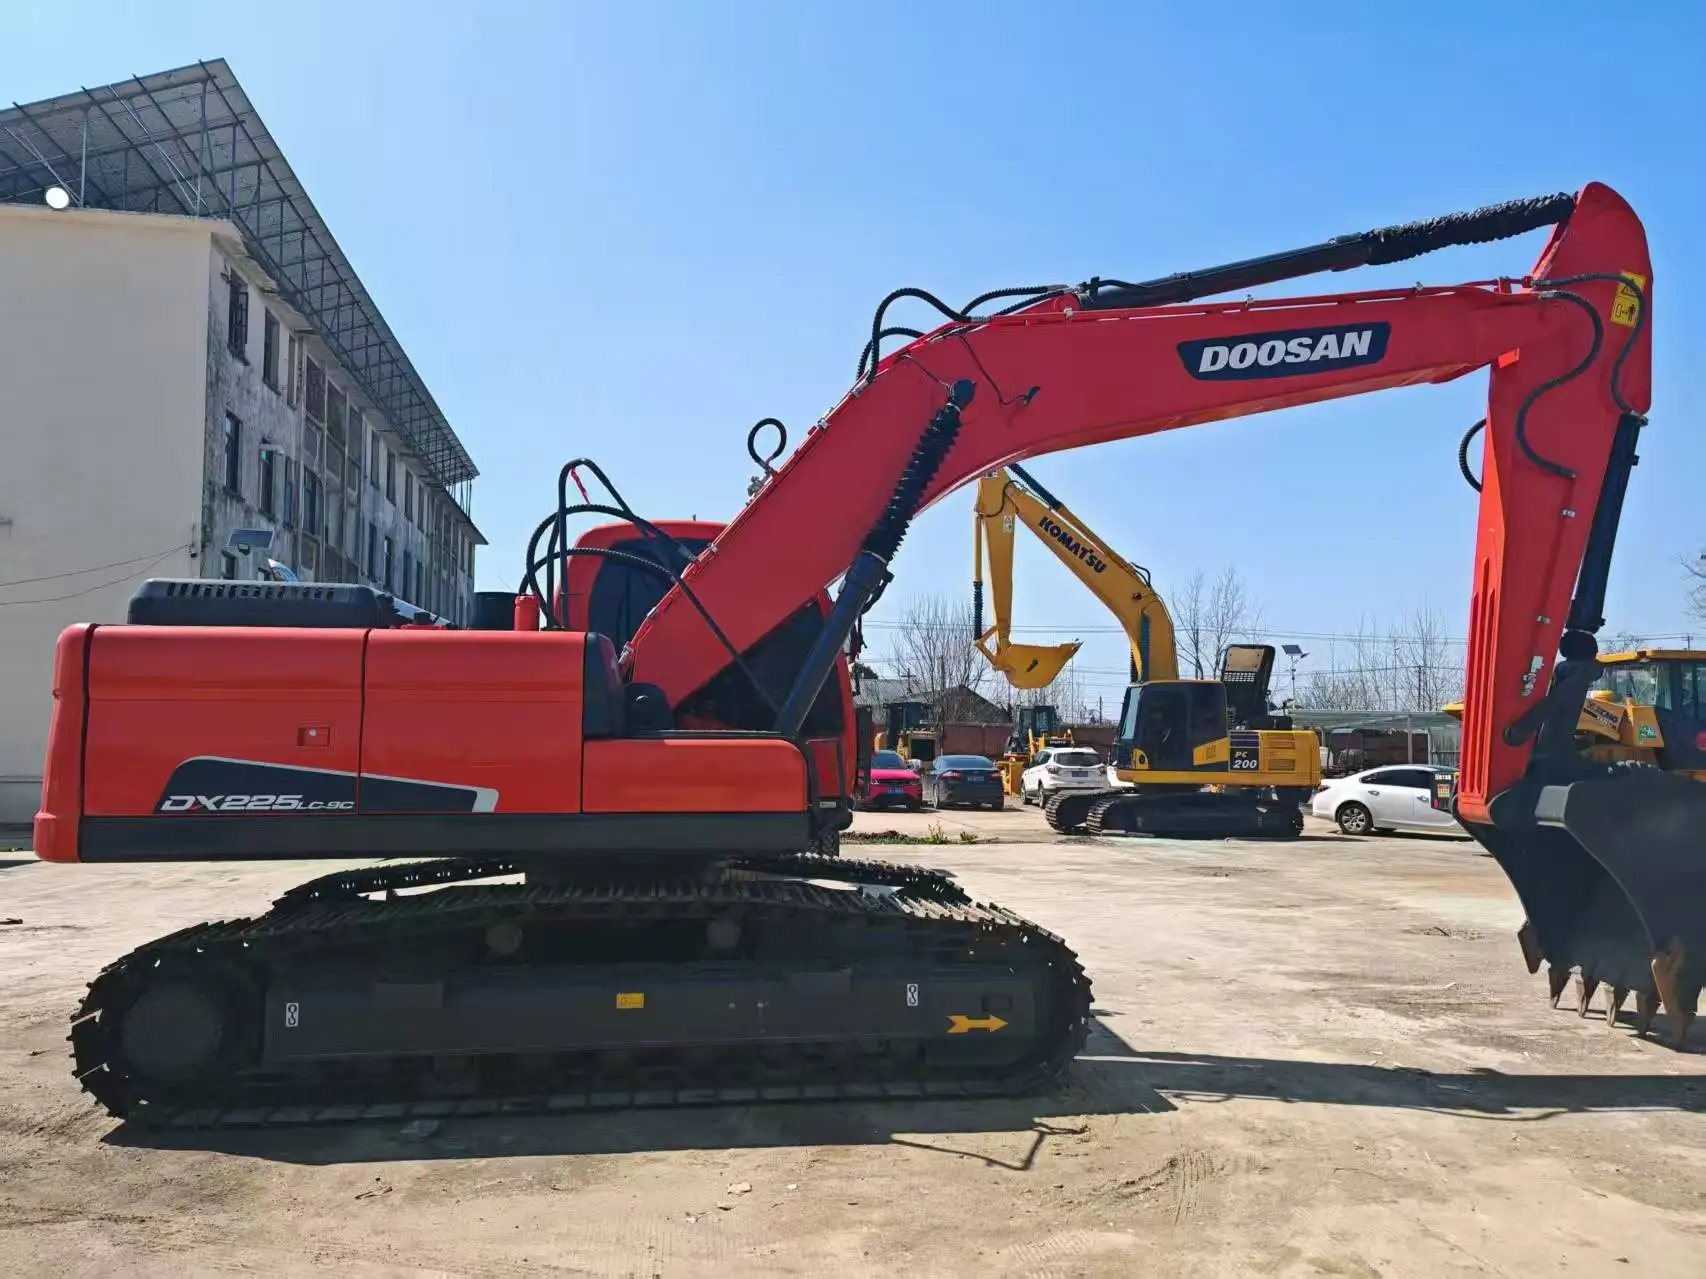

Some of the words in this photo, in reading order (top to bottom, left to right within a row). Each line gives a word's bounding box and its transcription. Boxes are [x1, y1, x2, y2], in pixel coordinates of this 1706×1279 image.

[1199, 330, 1373, 373] DOOSAN
[1038, 515, 1108, 574] KOMATSU
[1232, 759, 1258, 769] 200
